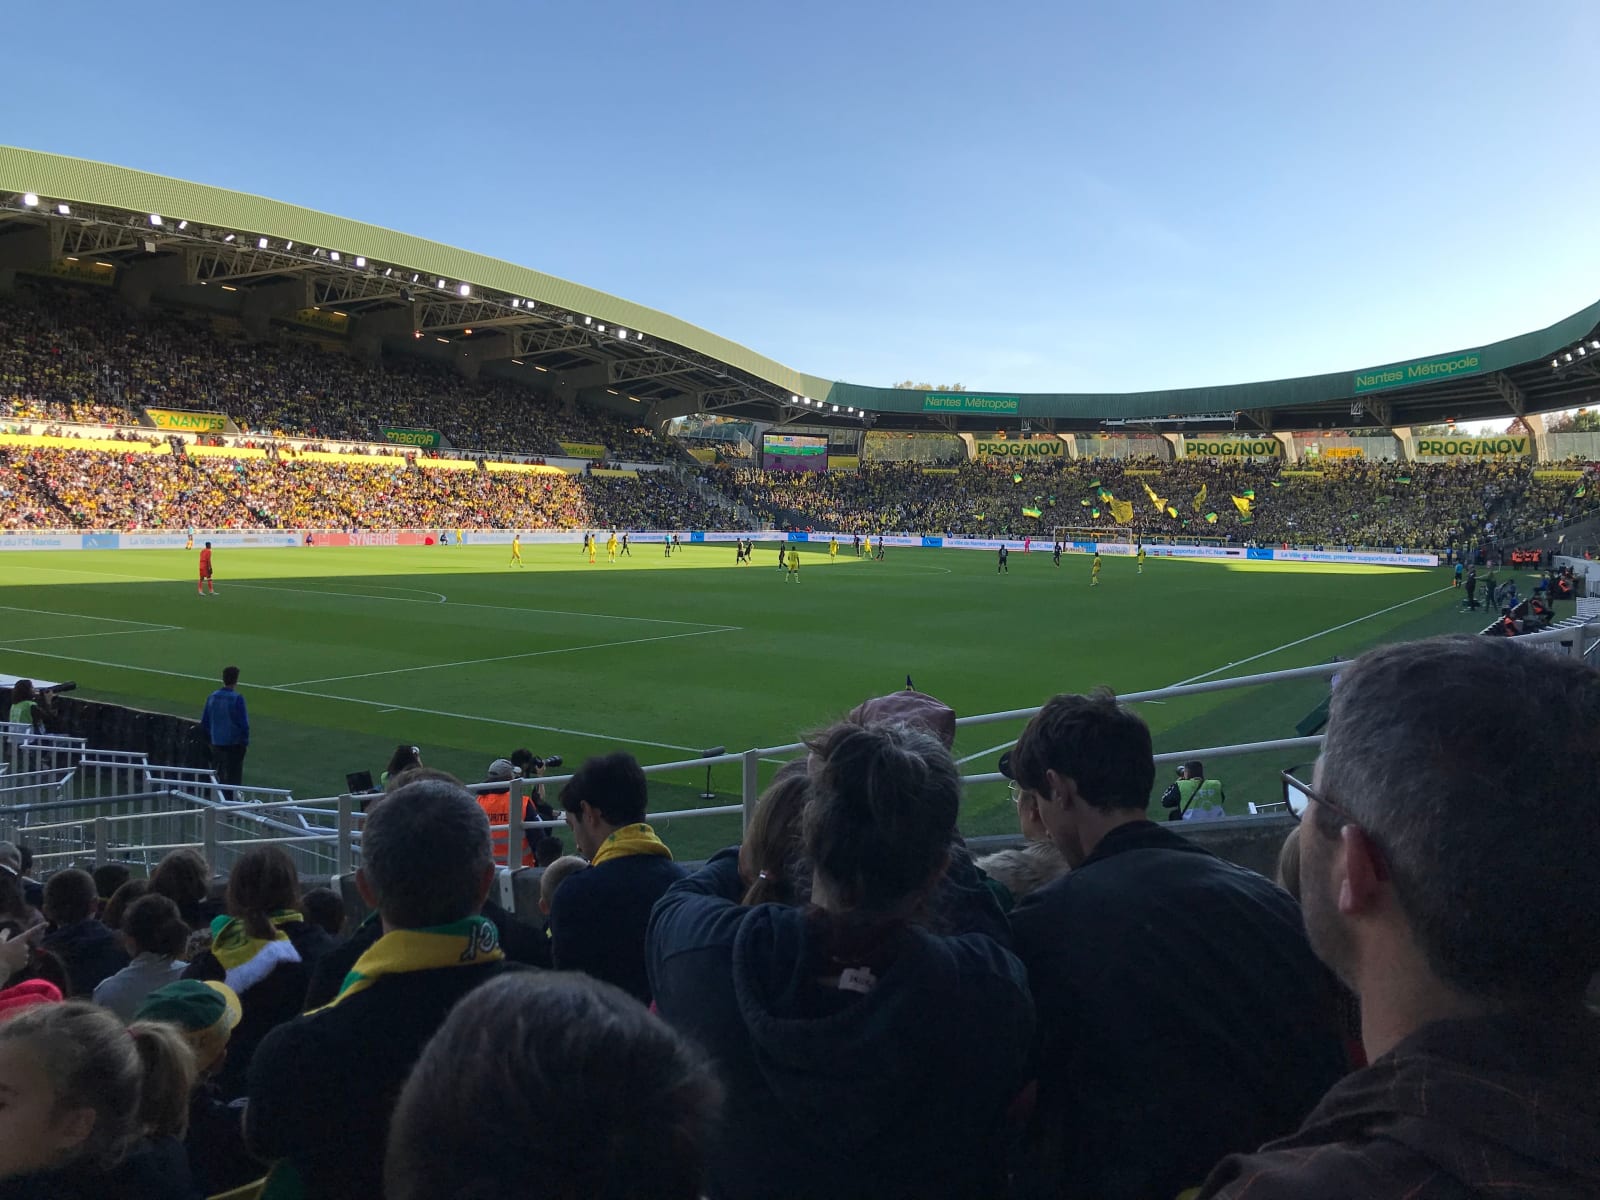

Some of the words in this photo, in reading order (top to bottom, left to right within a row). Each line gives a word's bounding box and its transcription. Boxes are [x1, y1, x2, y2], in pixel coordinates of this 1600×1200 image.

[1356, 371, 1404, 387] Nantes
[1408, 356, 1479, 378] Métropole
[925, 397, 961, 407] Nantes
[964, 398, 1017, 410] Métropole
[169, 415, 224, 430] NANTES
[349, 534, 398, 545] SYNERGIE
[1358, 555, 1387, 563] supporter
